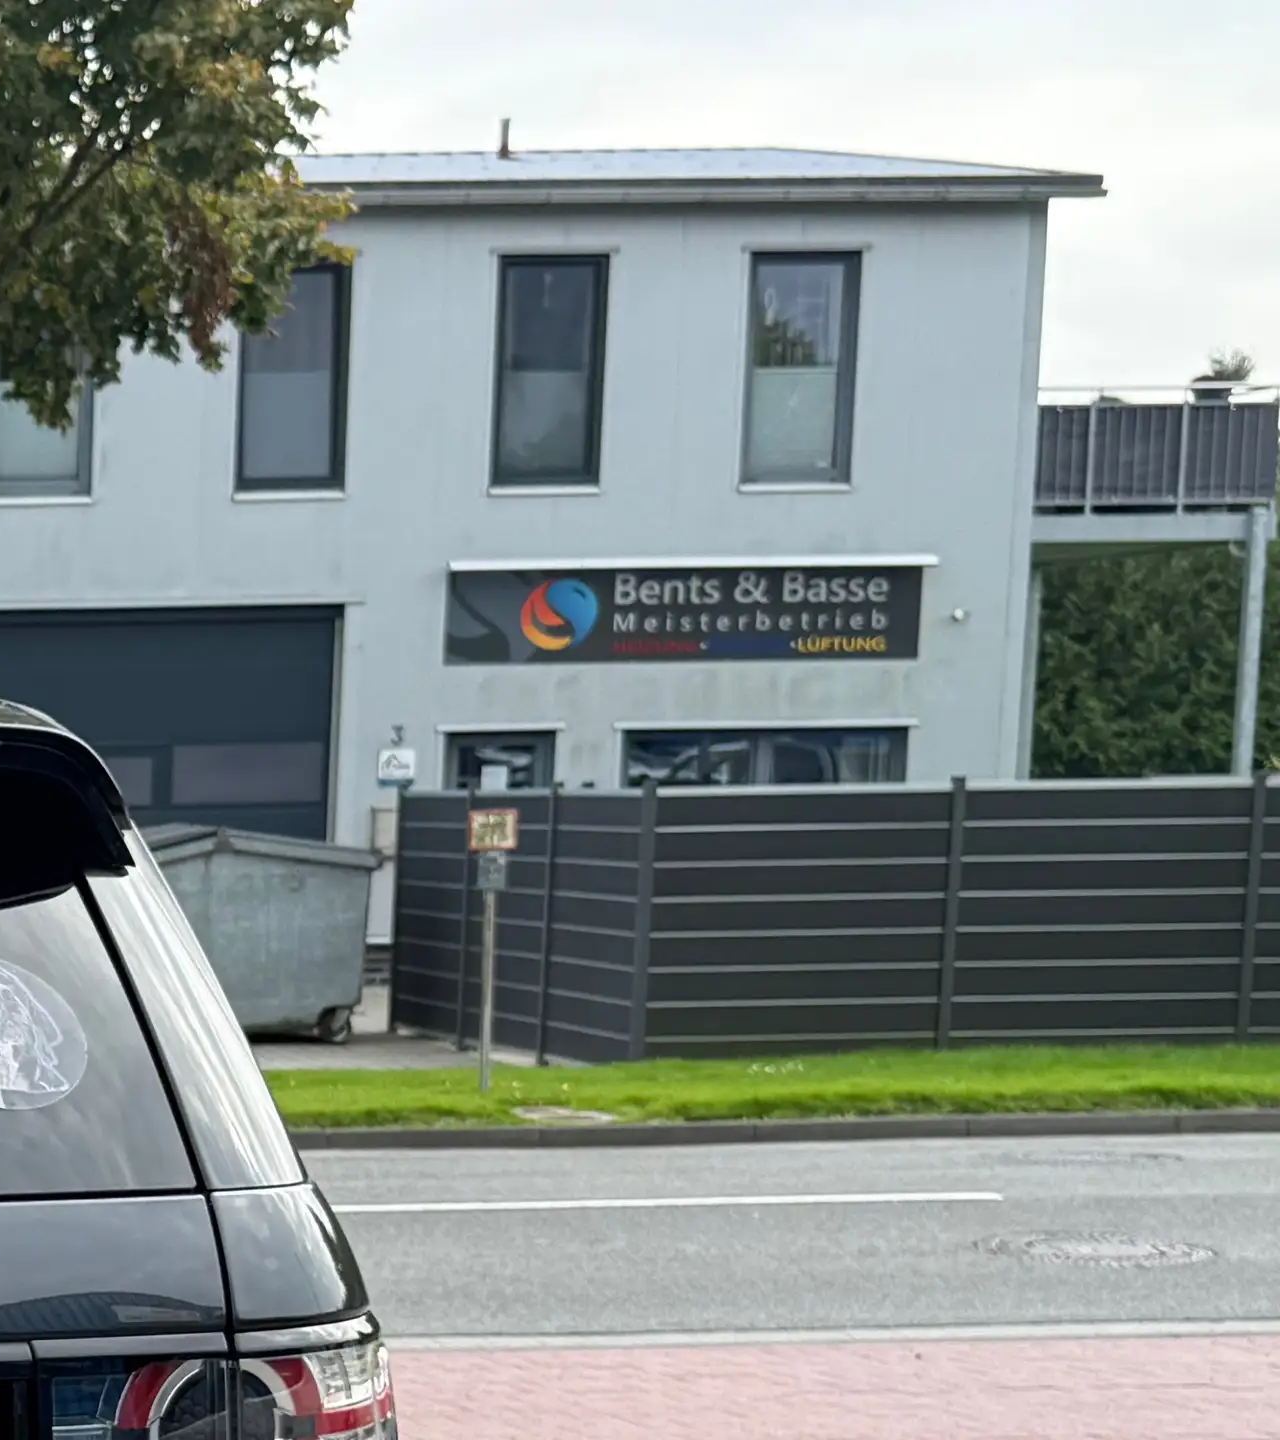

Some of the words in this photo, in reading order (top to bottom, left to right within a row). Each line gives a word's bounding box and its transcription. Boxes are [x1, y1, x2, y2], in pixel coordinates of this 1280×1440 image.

[614, 572, 721, 606] Bents
[734, 571, 768, 603] &
[783, 570, 890, 603] Basse
[612, 609, 889, 634] Meisterbetrieb
[797, 634, 888, 653] LÜFTUNG
